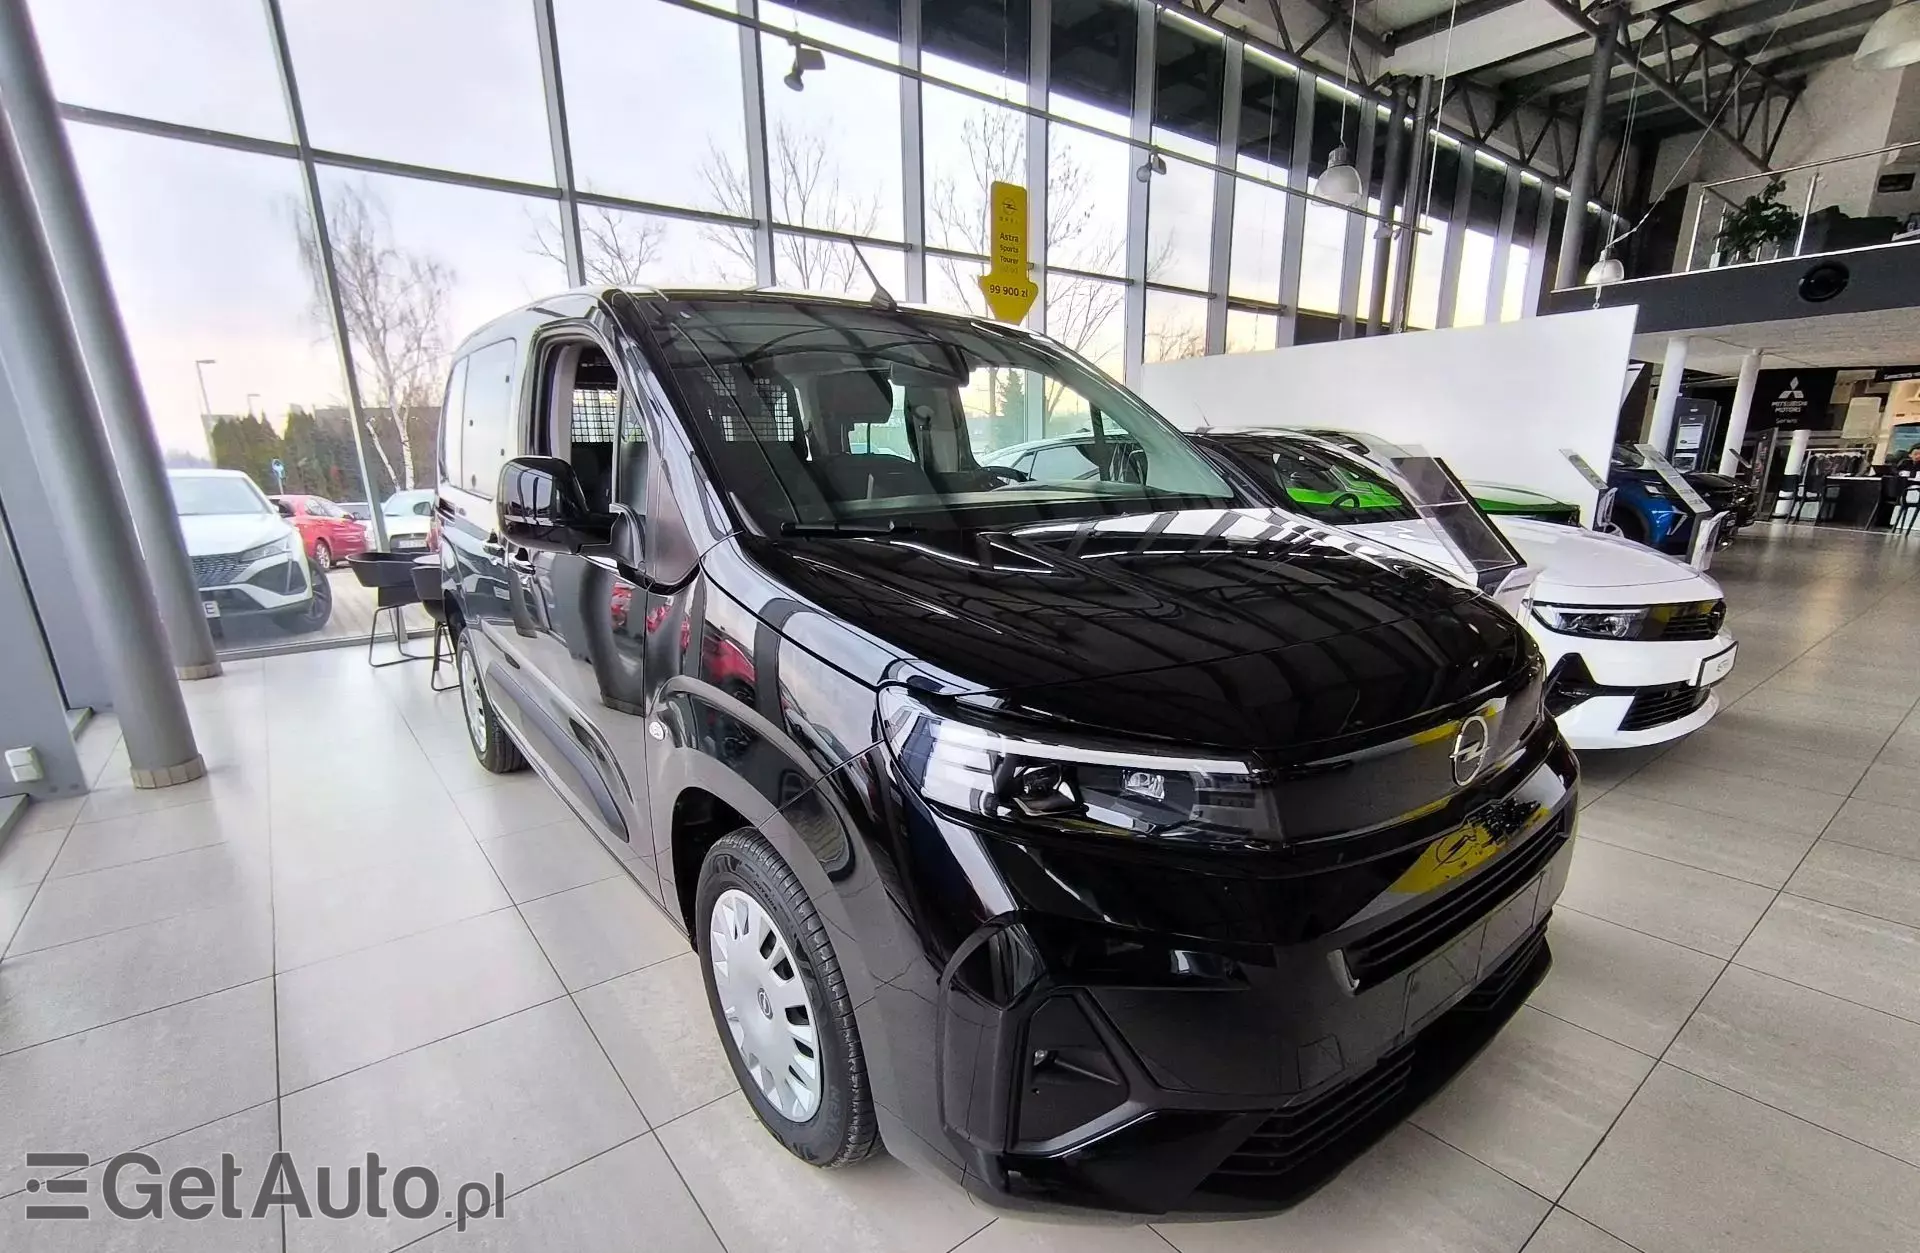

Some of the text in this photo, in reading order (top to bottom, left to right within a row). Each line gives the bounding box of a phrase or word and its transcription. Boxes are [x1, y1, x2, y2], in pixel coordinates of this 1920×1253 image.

[1000, 232, 1019, 242] Astra
[1000, 255, 1019, 265] Tourer
[990, 284, 1001, 294] 99
[1003, 286, 1019, 297] 900
